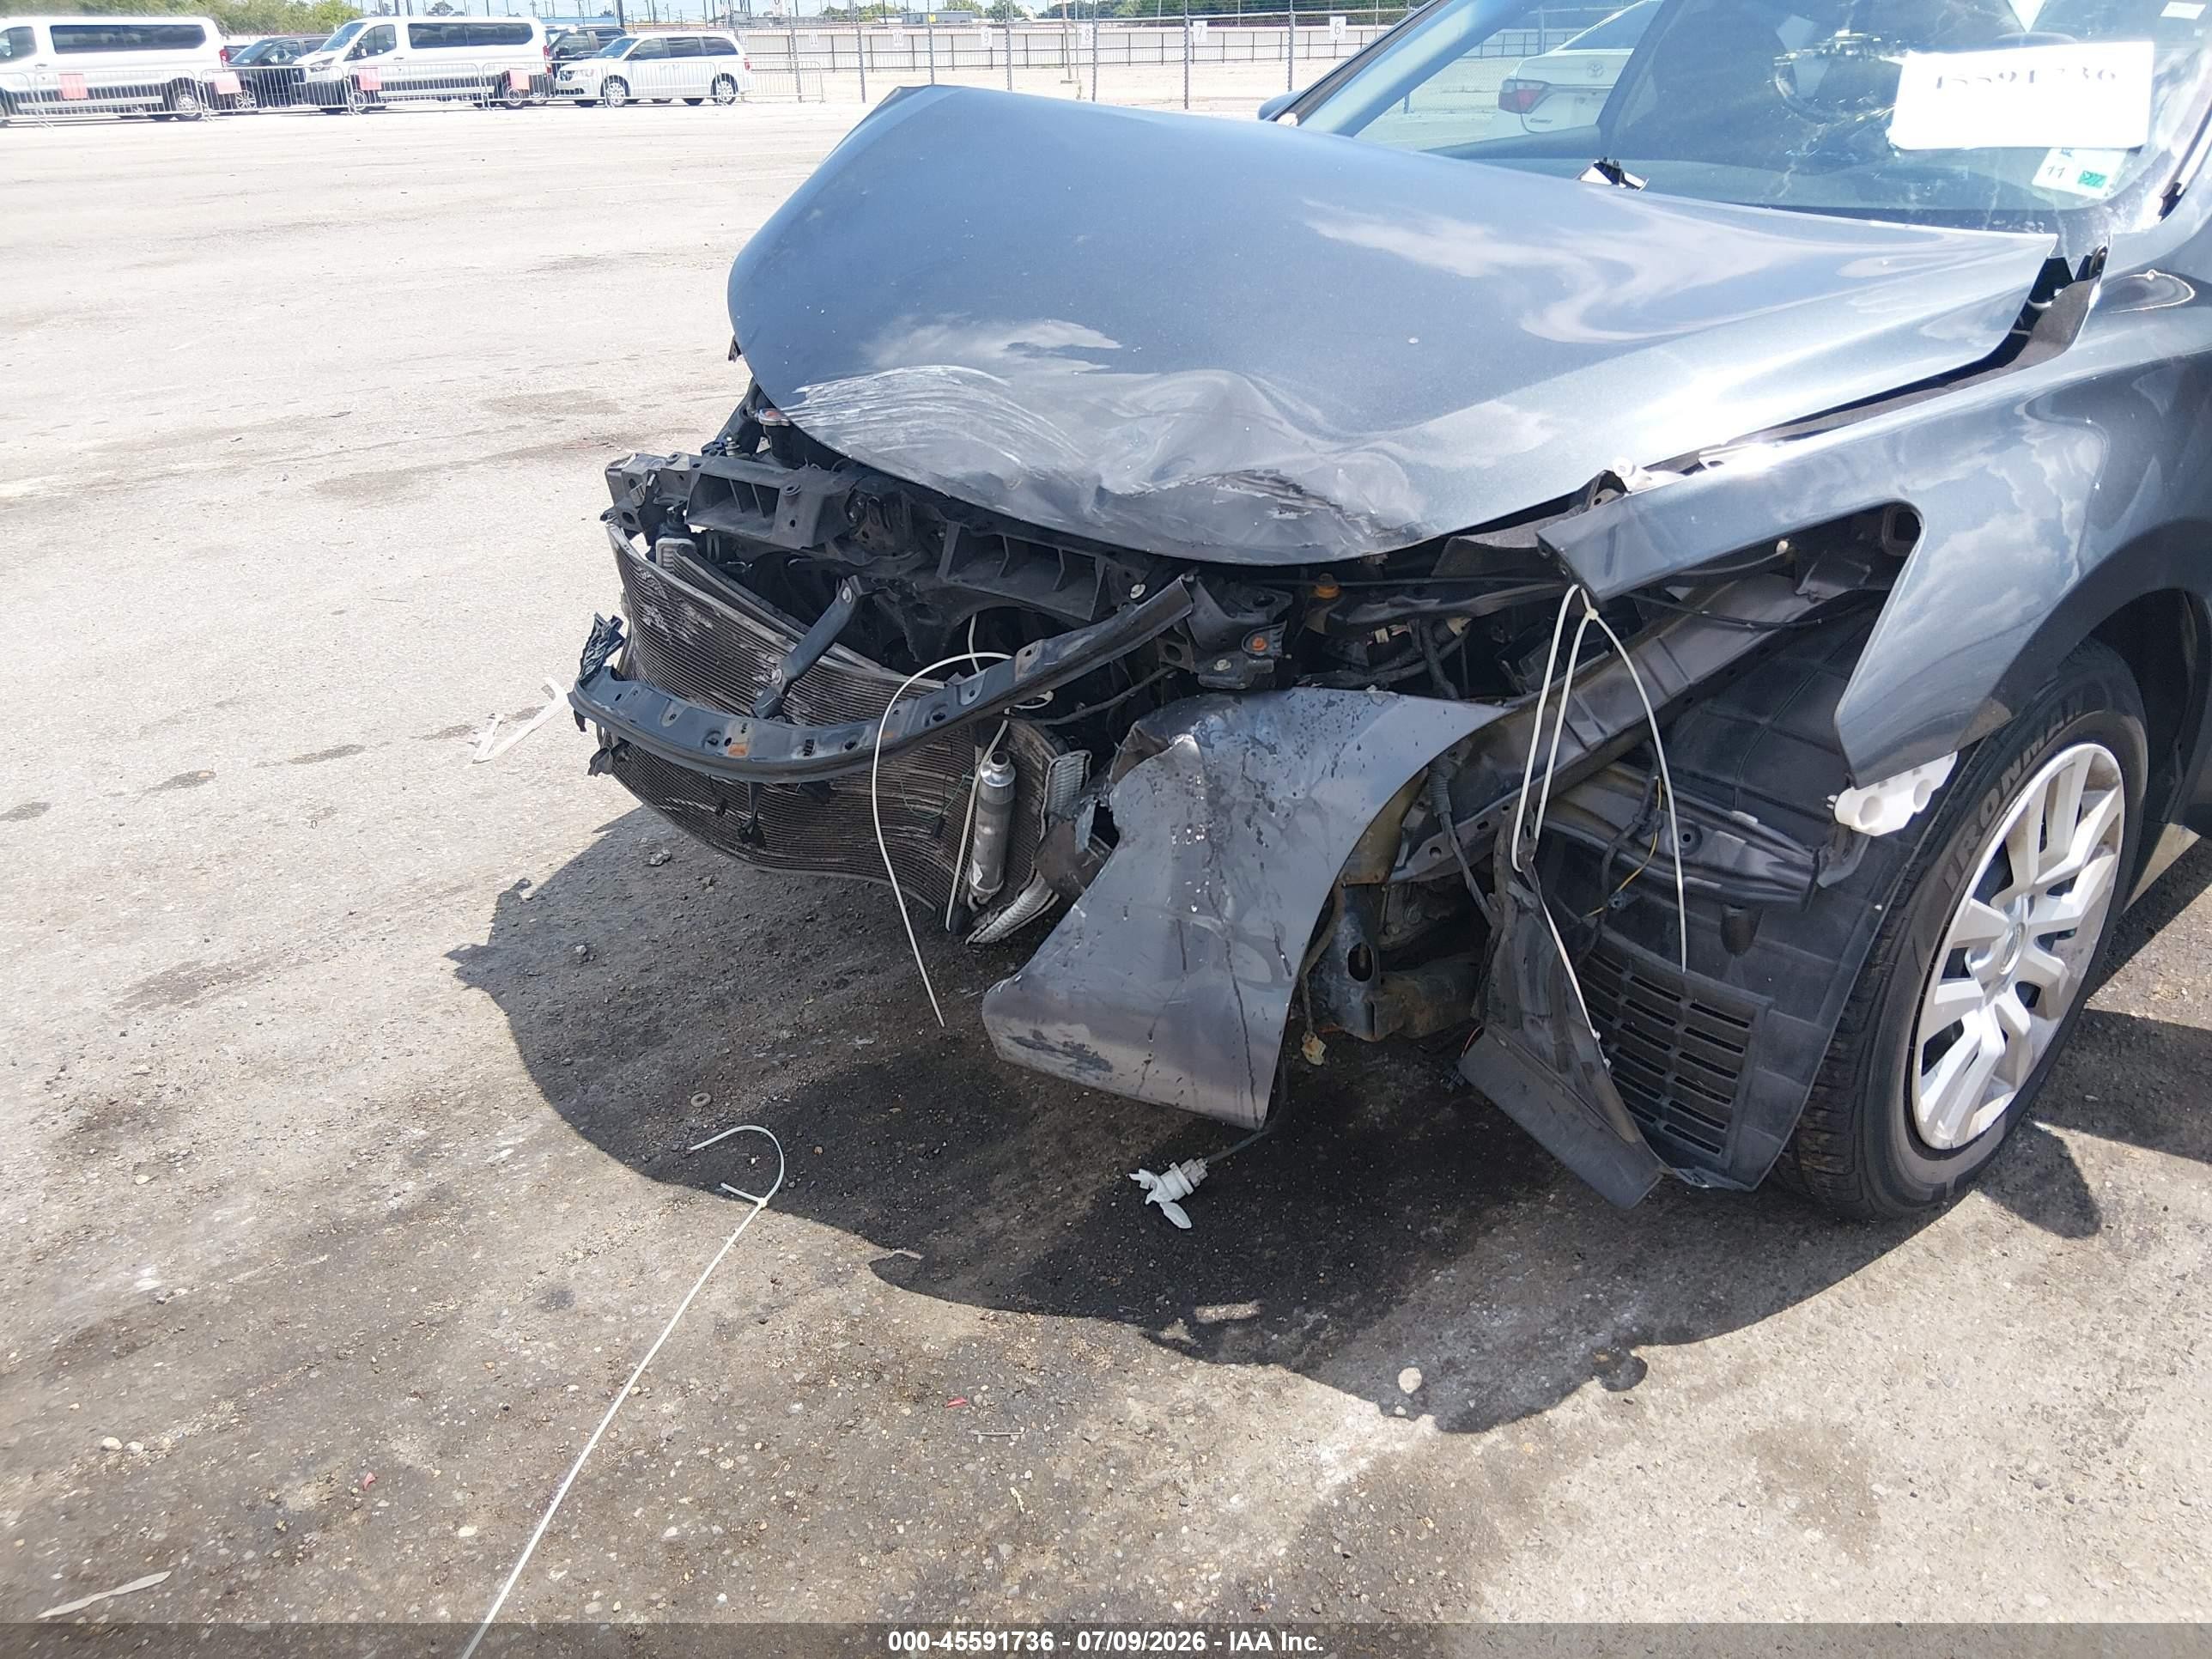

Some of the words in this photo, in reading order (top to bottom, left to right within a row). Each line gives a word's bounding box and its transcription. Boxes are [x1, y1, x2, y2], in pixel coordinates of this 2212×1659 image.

[1085, 28, 1091, 41] 8
[1334, 21, 1341, 35] 6
[983, 30, 989, 43] 9
[1943, 697, 2083, 892] IRONMAN
